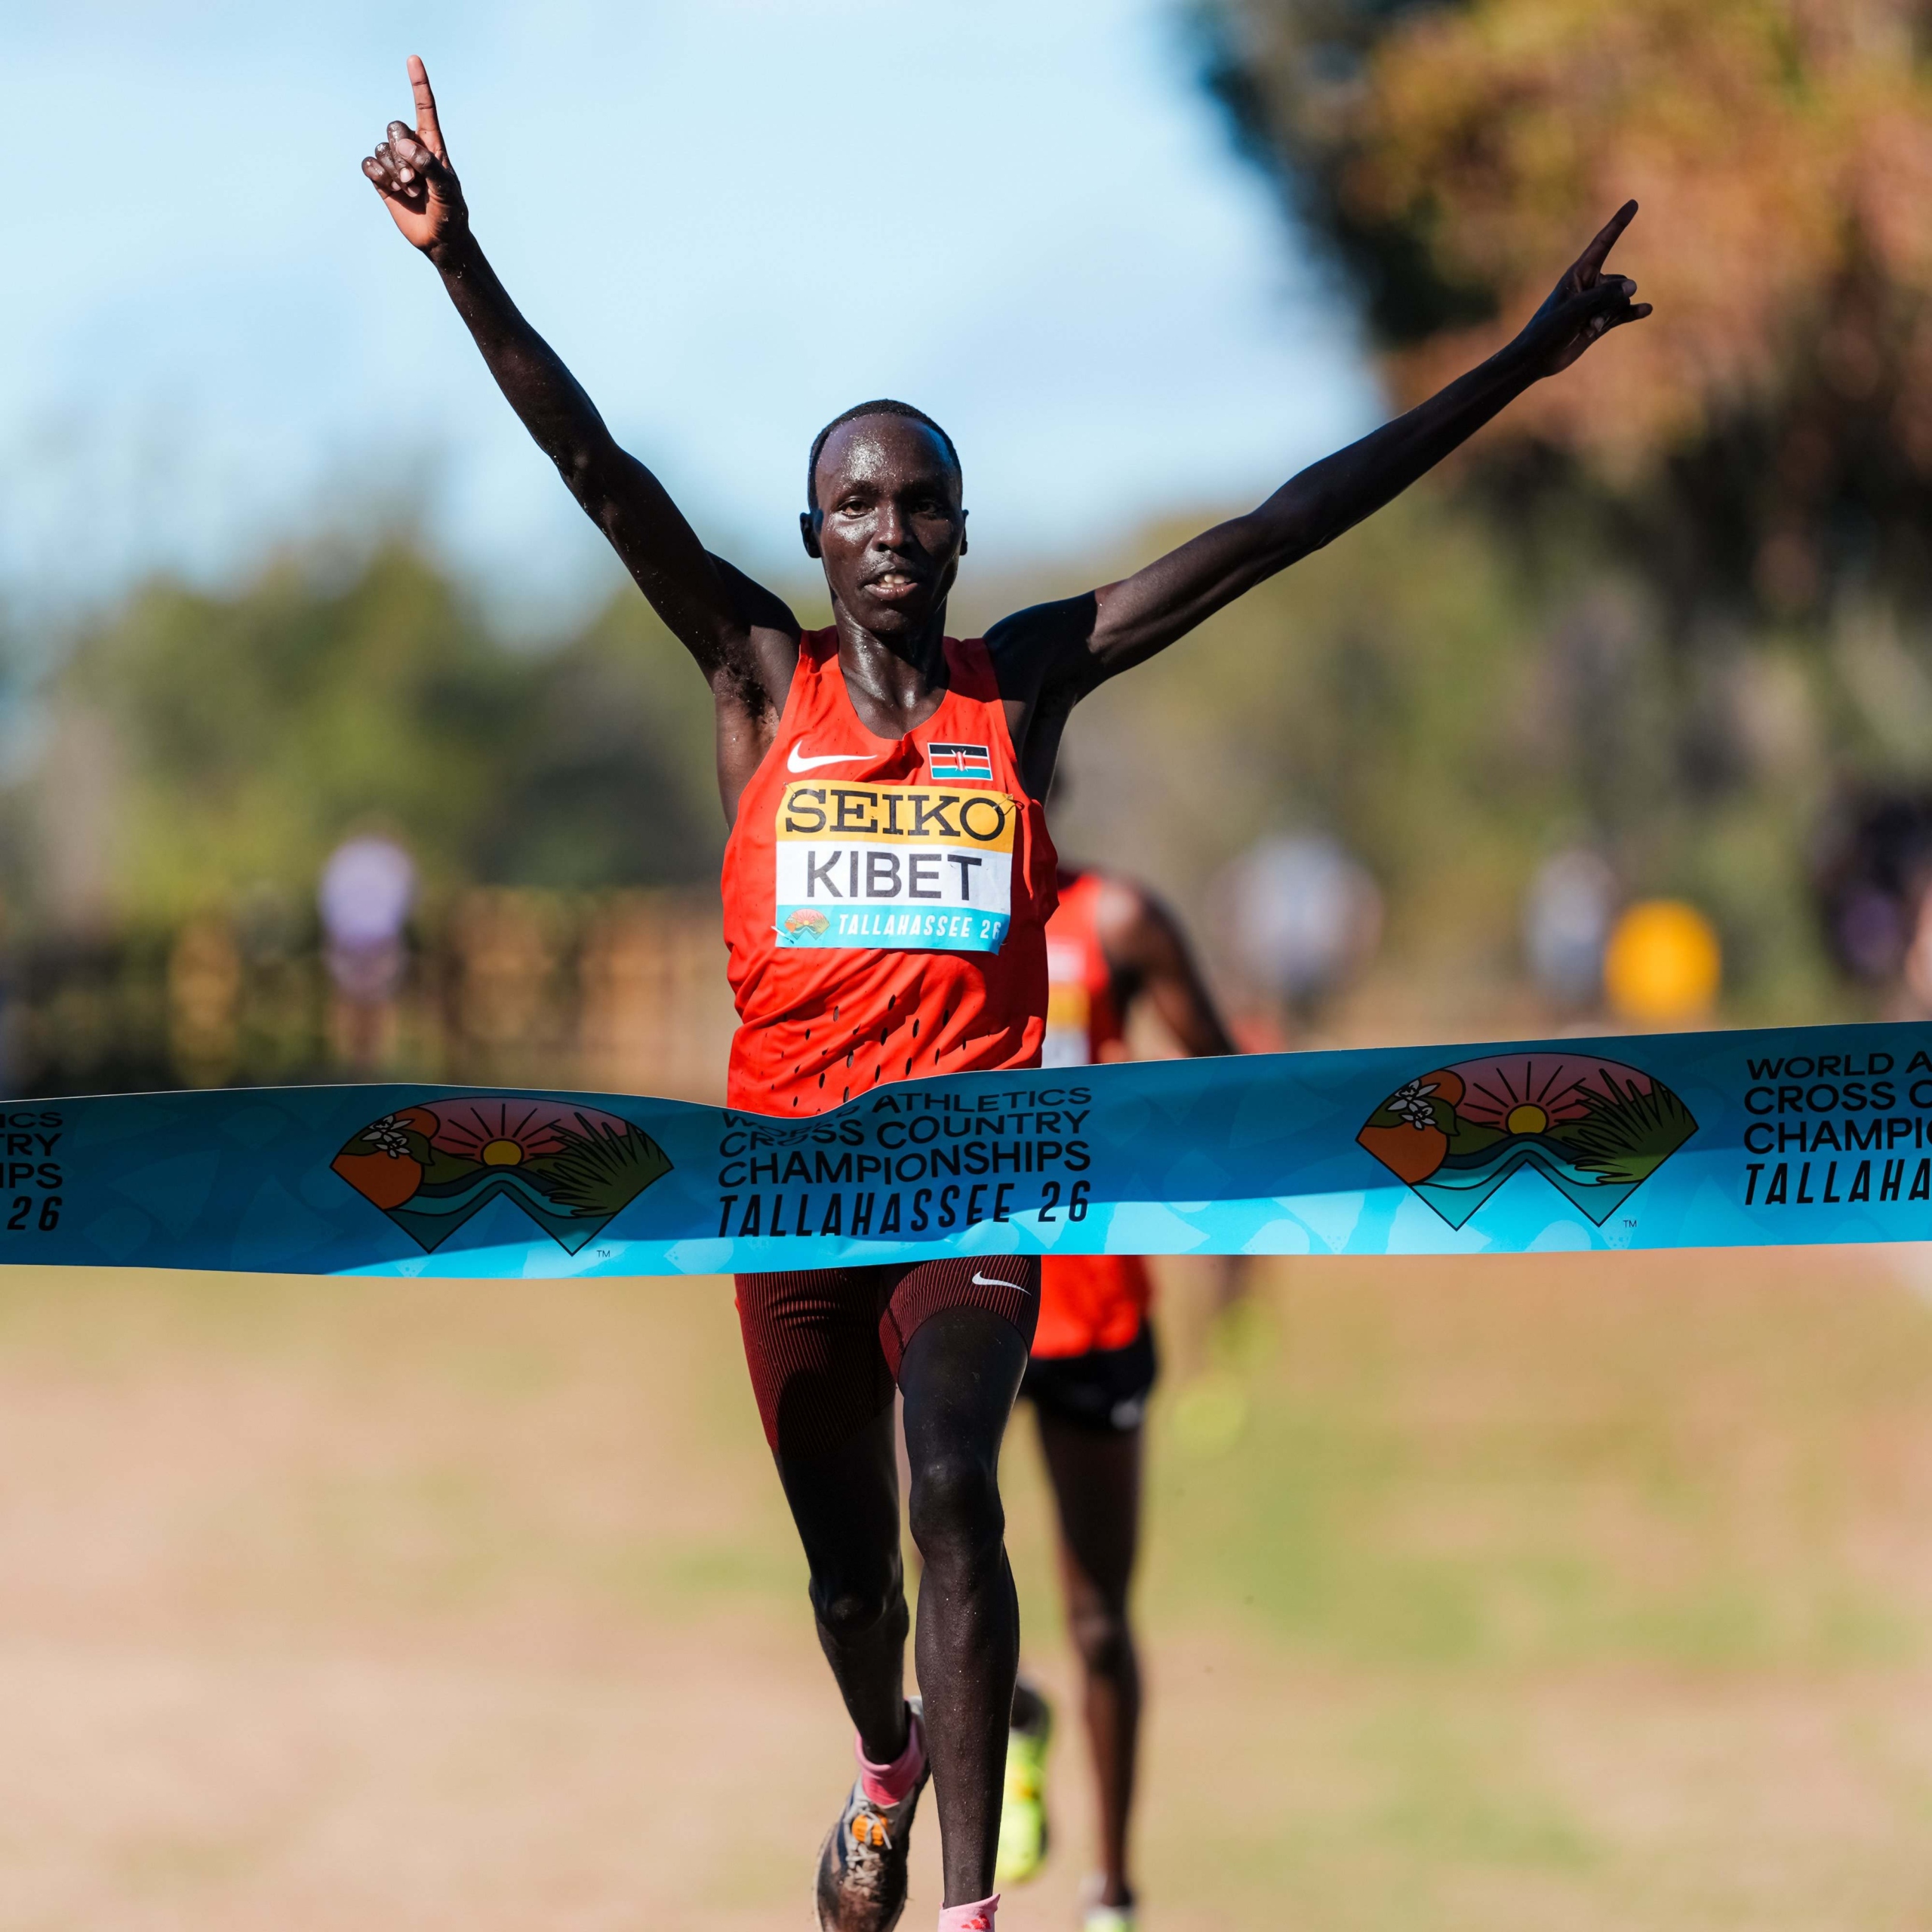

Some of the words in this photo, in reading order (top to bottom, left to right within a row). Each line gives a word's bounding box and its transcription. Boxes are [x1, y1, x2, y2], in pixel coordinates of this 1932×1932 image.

[786, 789, 1004, 841] SEIKO
[807, 851, 982, 900] KIBET
[838, 914, 973, 937] TALLAHASSEE
[980, 919, 1001, 940] 26
[1746, 1052, 1894, 1080] WORLD
[872, 1087, 1091, 1113] ATHLETICS
[1744, 1081, 1896, 1115] CROSS
[719, 1119, 865, 1158] CROSS
[876, 1109, 1091, 1150] COUNTRY
[1744, 1117, 1932, 1155] CHAMPI
[718, 1140, 1091, 1188] CHAMPIONSHIPS
[1745, 1158, 1931, 1205] TALLAHA
[7, 1195, 63, 1231] 26
[718, 1183, 1014, 1238] TALLAHASSEE
[1038, 1180, 1091, 1223] 26
